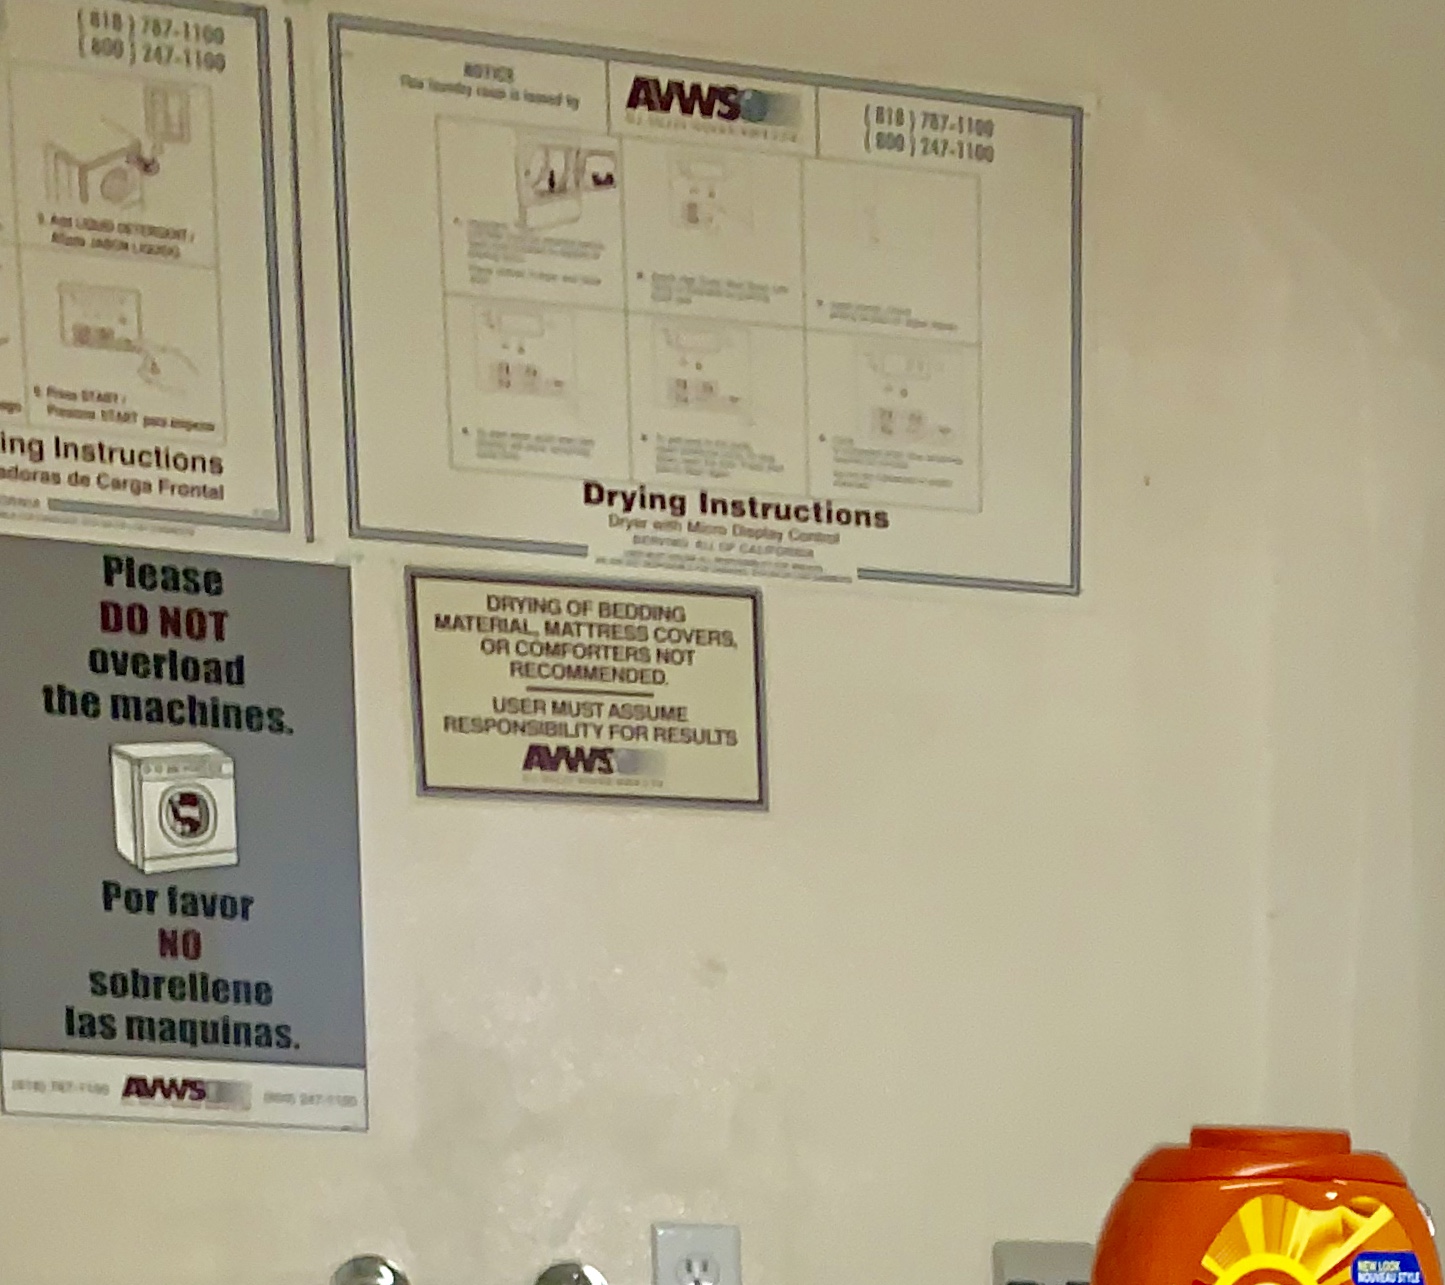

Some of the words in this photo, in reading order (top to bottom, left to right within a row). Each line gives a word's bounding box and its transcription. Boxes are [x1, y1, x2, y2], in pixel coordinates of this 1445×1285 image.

[54, 434, 225, 476] Instructions
[583, 477, 687, 518] Drying
[699, 488, 890, 530] Instructions
[102, 553, 225, 597] Please
[100, 599, 149, 636] DO
[158, 604, 230, 643] NOT
[486, 593, 562, 617] DRYING
[566, 597, 593, 618] OF
[597, 601, 687, 624] BEDDING
[544, 618, 650, 643] MATTRESS
[88, 646, 246, 687] overload
[480, 638, 511, 656] OR
[514, 639, 652, 664] COMFORTERS
[655, 648, 696, 667] NOT
[509, 660, 670, 687] RECOMMENDED.
[42, 683, 102, 720] the
[110, 691, 295, 737] machines.
[492, 696, 547, 717] USER
[550, 699, 605, 720] MUST
[607, 702, 689, 724] ASSUME
[443, 715, 604, 740] RESPONSIBILITY
[608, 724, 649, 743] FOR
[652, 726, 739, 748] RESULTS
[102, 878, 159, 915] Por
[166, 883, 255, 922] favor
[158, 927, 203, 961] NO
[88, 967, 274, 1007] sobrellene
[65, 1005, 118, 1041] las
